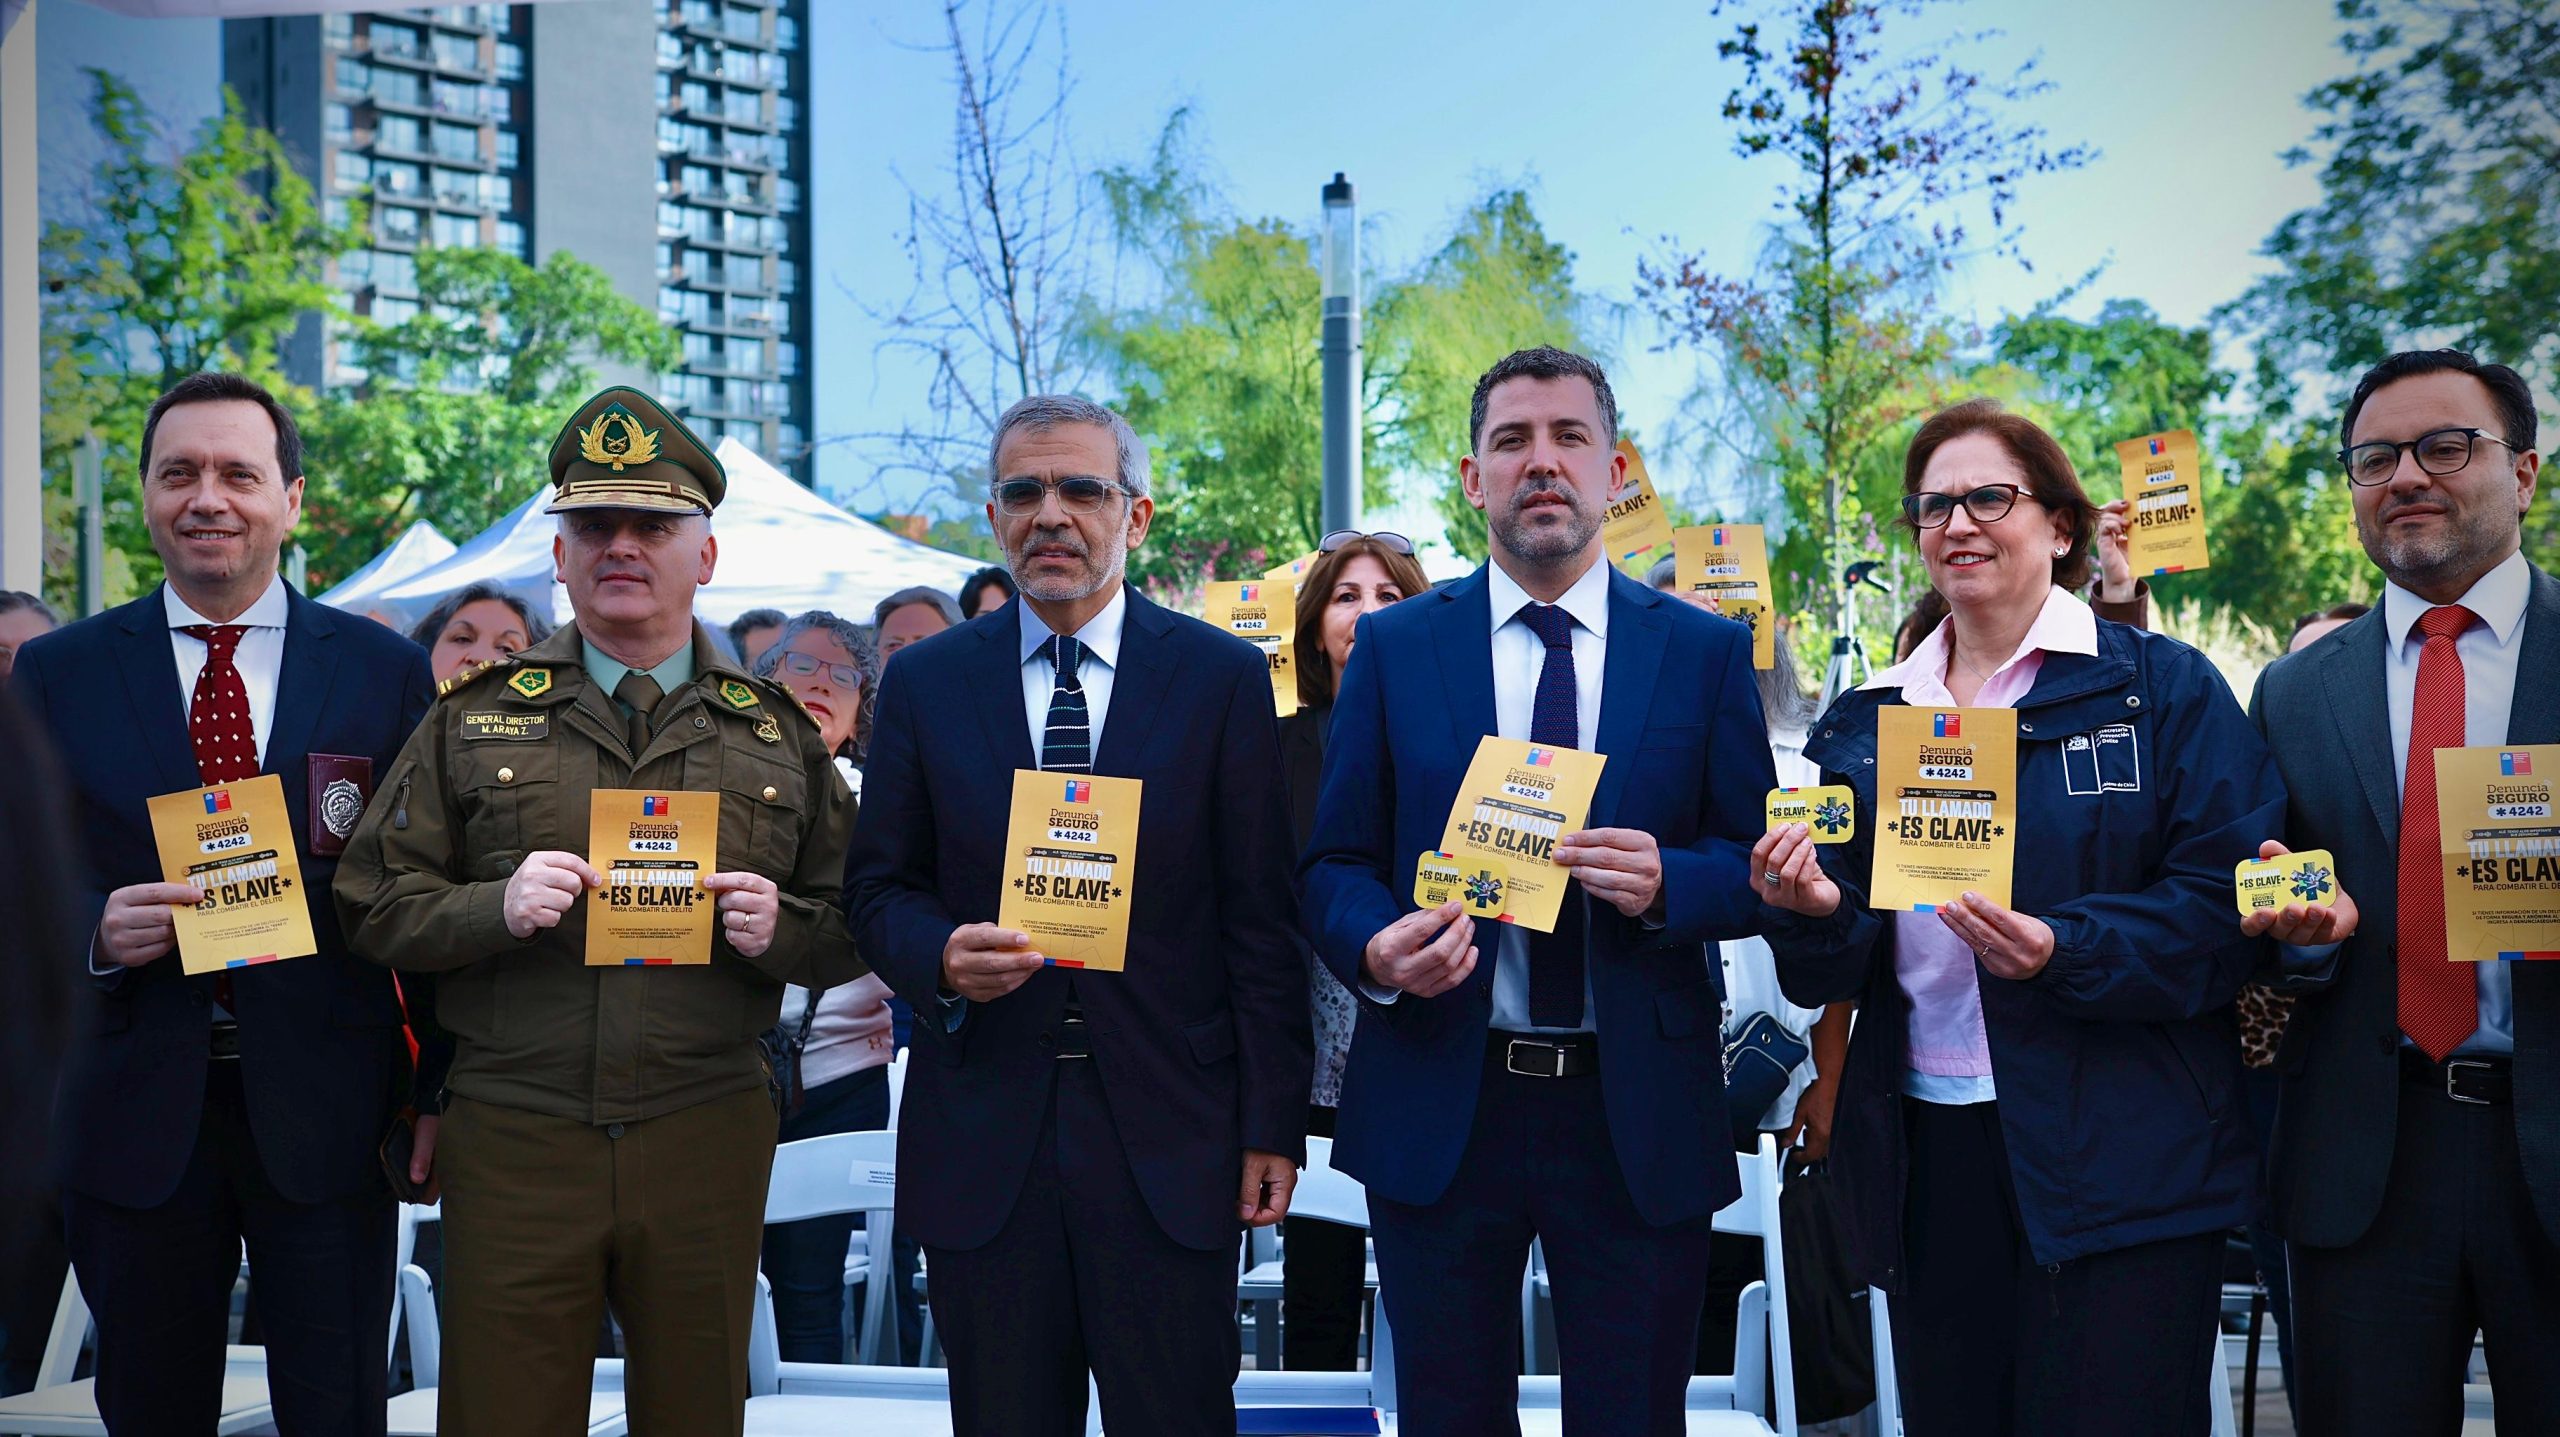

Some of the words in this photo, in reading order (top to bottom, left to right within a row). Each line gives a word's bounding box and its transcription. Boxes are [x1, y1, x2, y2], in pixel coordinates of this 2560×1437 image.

[1705, 558, 1739, 566] SEGURO
[466, 715, 504, 724] GENERAL
[506, 716, 544, 725] DIRECTOR
[481, 725, 491, 733] M.
[492, 725, 519, 735] ARAYA
[521, 727, 529, 735] Z.
[1920, 745, 1972, 756] Denuncia
[1919, 755, 1973, 765] SEGURO
[1508, 767, 1556, 782] Denuncia
[1504, 774, 1554, 791] SEGURO
[2486, 783, 2548, 793] Denuncia
[2487, 793, 2550, 804] SEGURO
[1051, 808, 1099, 820] Denuncia
[1899, 799, 1917, 816] TU
[1922, 800, 1991, 819] LLAMADO
[197, 816, 247, 832] Denuncia
[630, 822, 678, 831] Denuncia
[1048, 818, 1098, 830] SEGURO
[1473, 804, 1491, 822] TU
[1494, 808, 1560, 838] LLAMADO
[197, 824, 249, 841] SEGURO
[629, 831, 678, 839] SEGURO
[1495, 827, 1556, 860] CLAVE
[2467, 841, 2489, 859] TU
[1466, 841, 1483, 850] PARA
[1484, 844, 1516, 859] COMBATIR
[1517, 852, 1526, 861] EL
[1526, 855, 1549, 867] DELITO
[187, 873, 206, 889] TU
[209, 860, 277, 888] LLAMADO
[1026, 858, 1043, 874] TU
[1046, 860, 1112, 881] LLAMADO
[609, 870, 626, 885] TU
[630, 870, 694, 886] LLAMADO
[197, 908, 215, 917] PARA
[217, 903, 249, 914] COMBATIR
[260, 896, 283, 906] DELITO
[1043, 898, 1075, 906] COMBATIR
